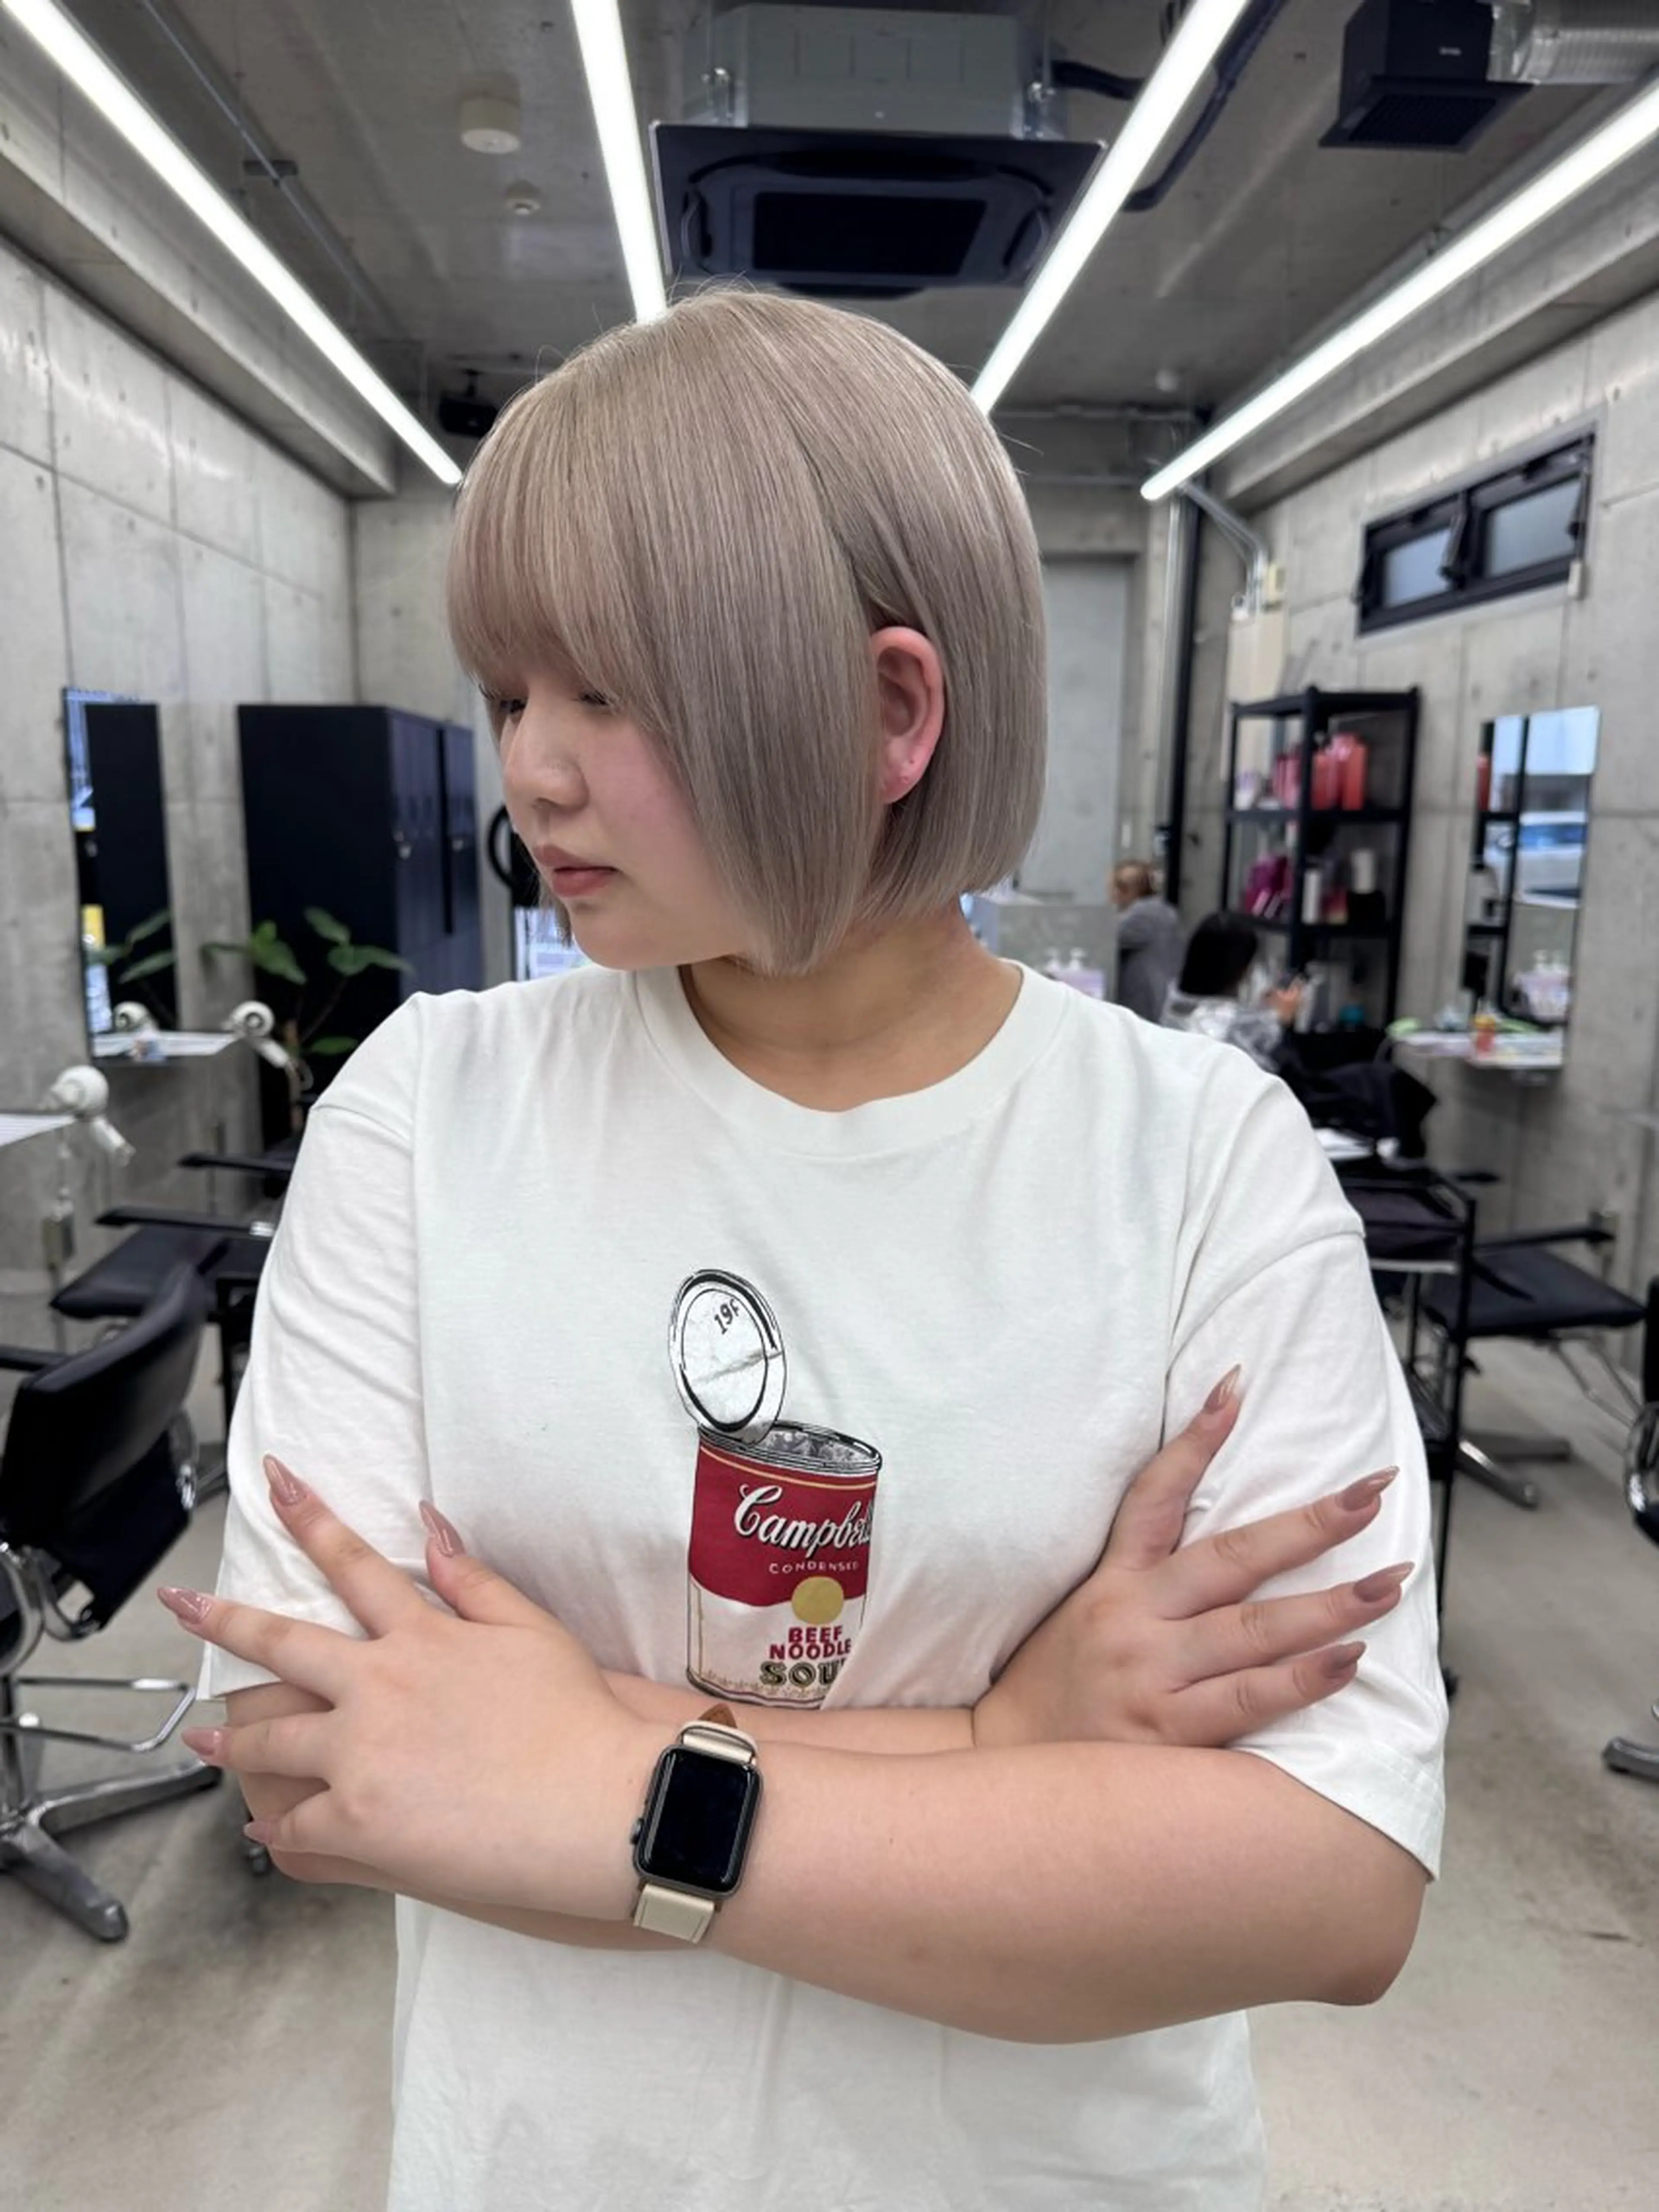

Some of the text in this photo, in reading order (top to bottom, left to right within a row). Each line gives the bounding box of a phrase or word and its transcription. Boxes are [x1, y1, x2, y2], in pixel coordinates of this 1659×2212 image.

[769, 1560, 859, 1574] CONDENSED
[788, 1625, 842, 1643] BEEF
[770, 1639, 851, 1659] NOODLE
[760, 1658, 845, 1687] SOU
